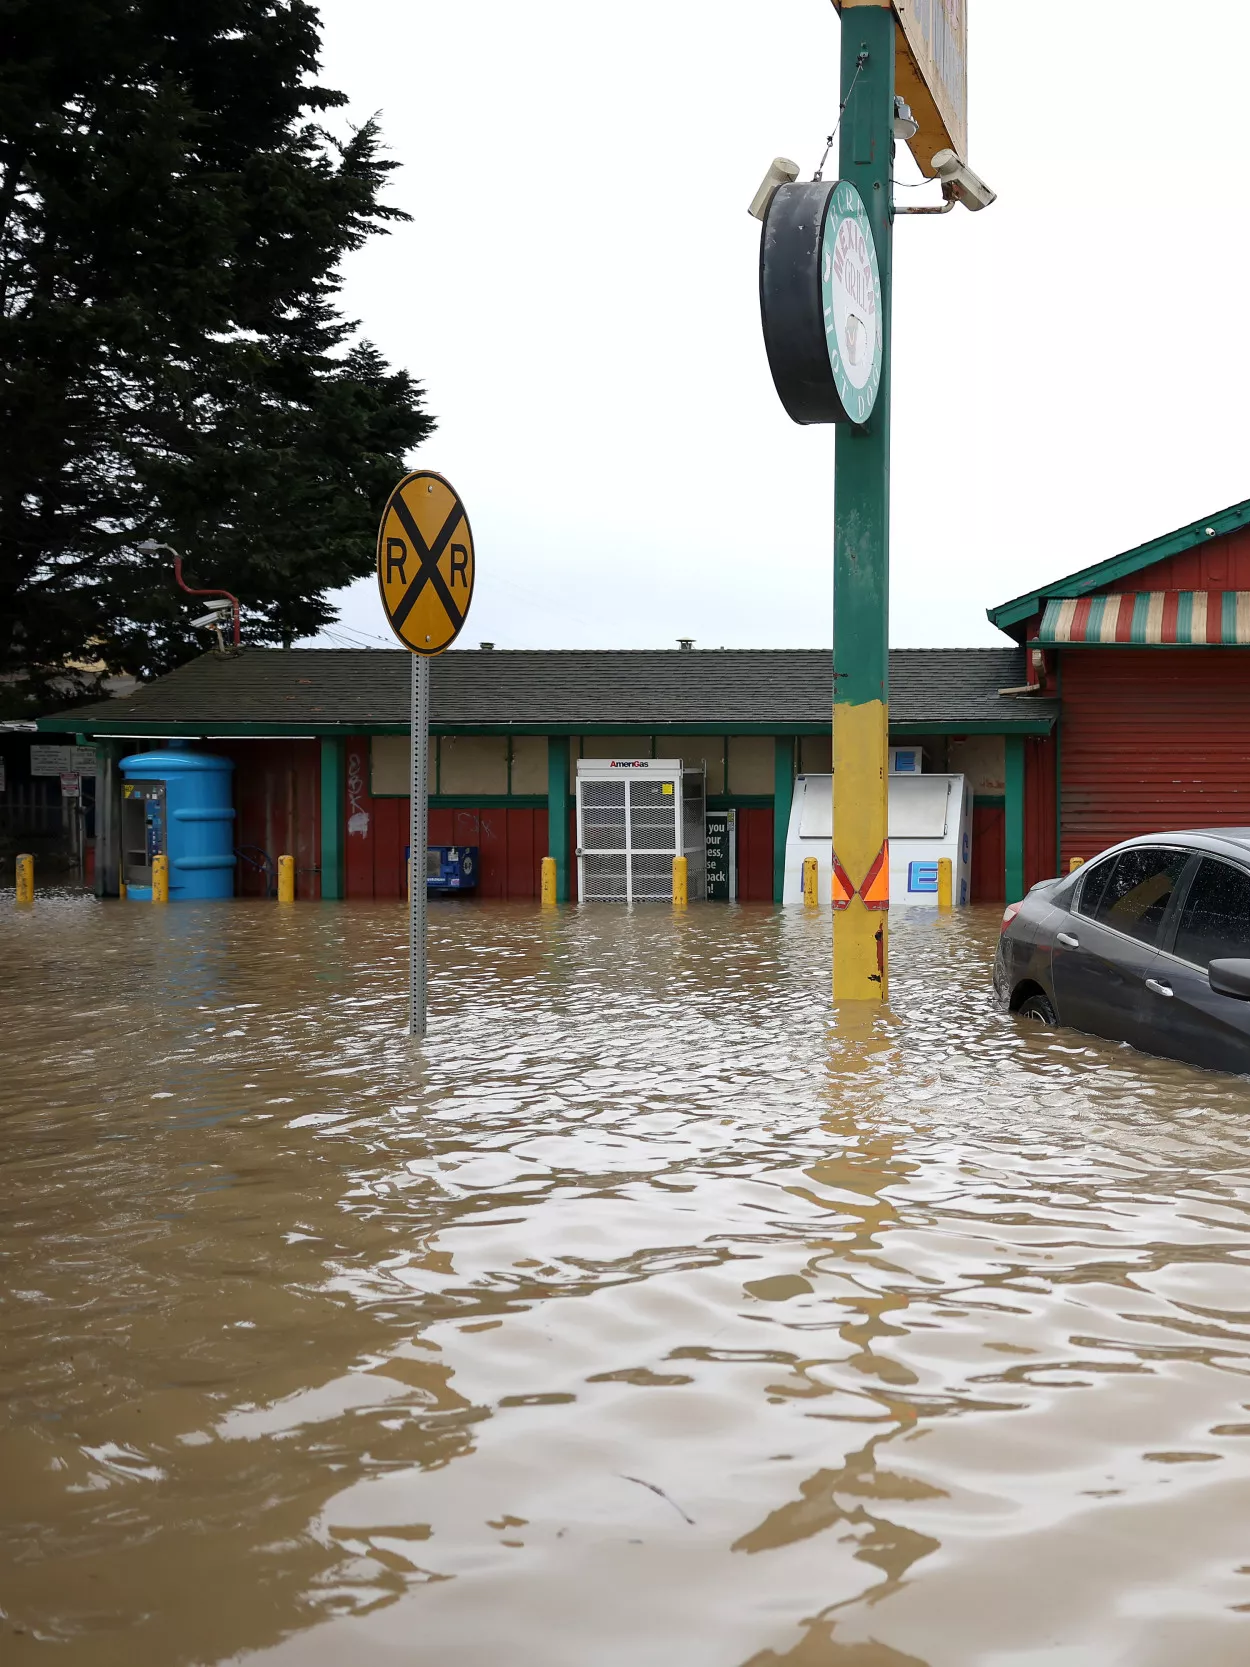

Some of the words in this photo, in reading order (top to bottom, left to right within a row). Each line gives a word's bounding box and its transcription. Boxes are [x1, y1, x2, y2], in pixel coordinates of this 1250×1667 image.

[845, 259, 867, 313] GRILL
[387, 537, 407, 584] R
[451, 543, 468, 588] R
[706, 836, 721, 845] our
[708, 824, 725, 835] you
